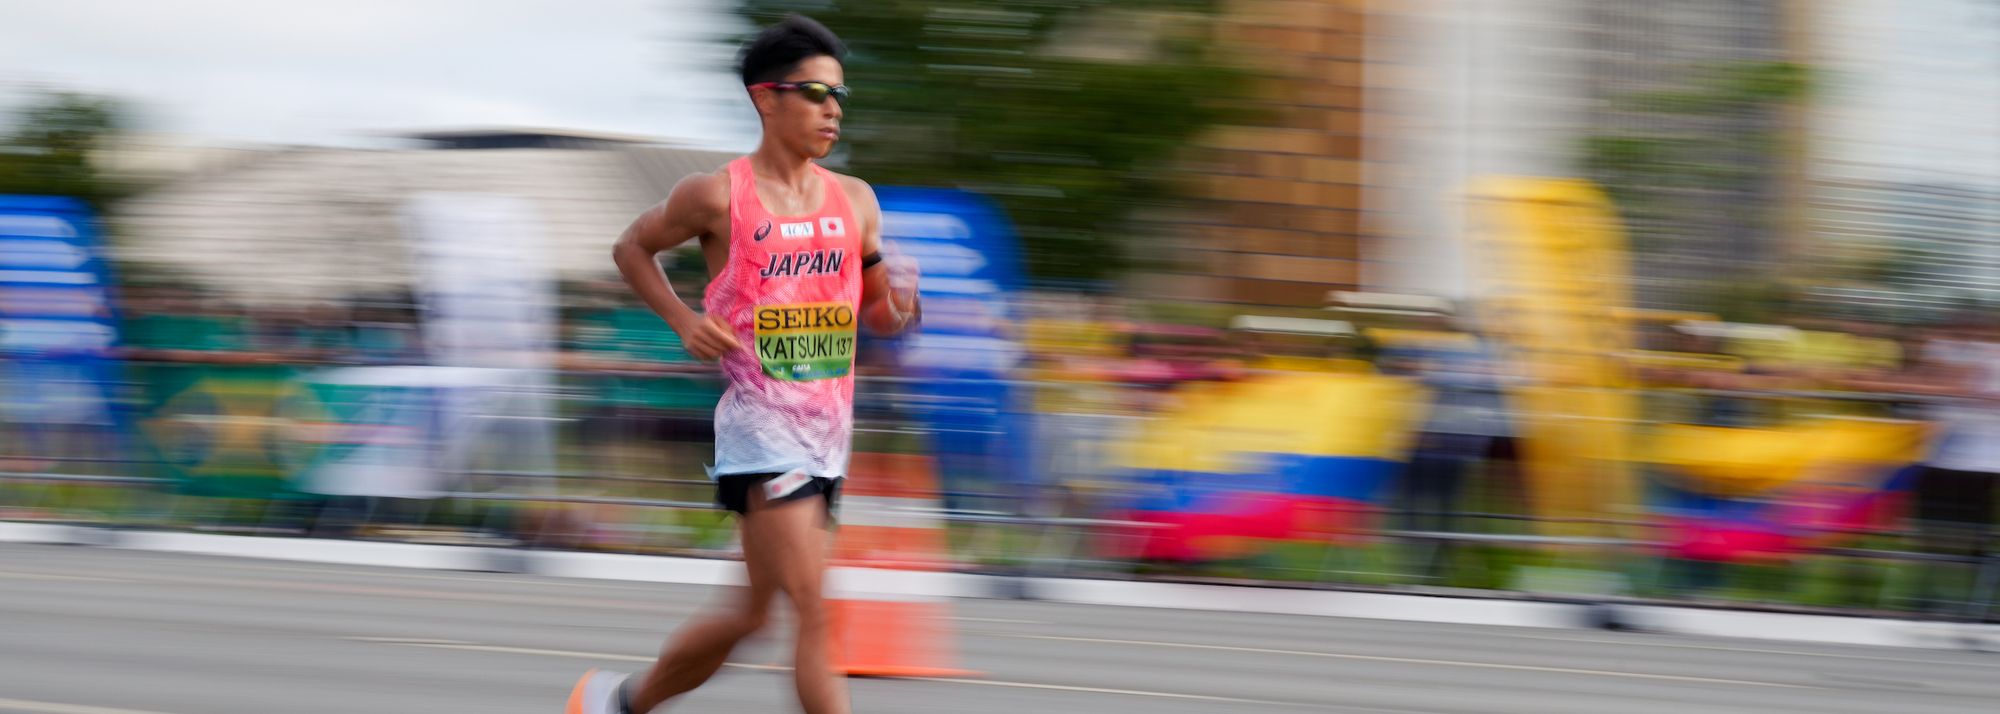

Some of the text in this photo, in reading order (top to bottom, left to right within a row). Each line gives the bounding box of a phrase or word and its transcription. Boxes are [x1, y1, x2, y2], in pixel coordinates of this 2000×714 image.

[760, 249, 844, 277] JAPAN
[758, 306, 853, 330] SEIKO
[760, 334, 853, 359] KATSUKI 137
